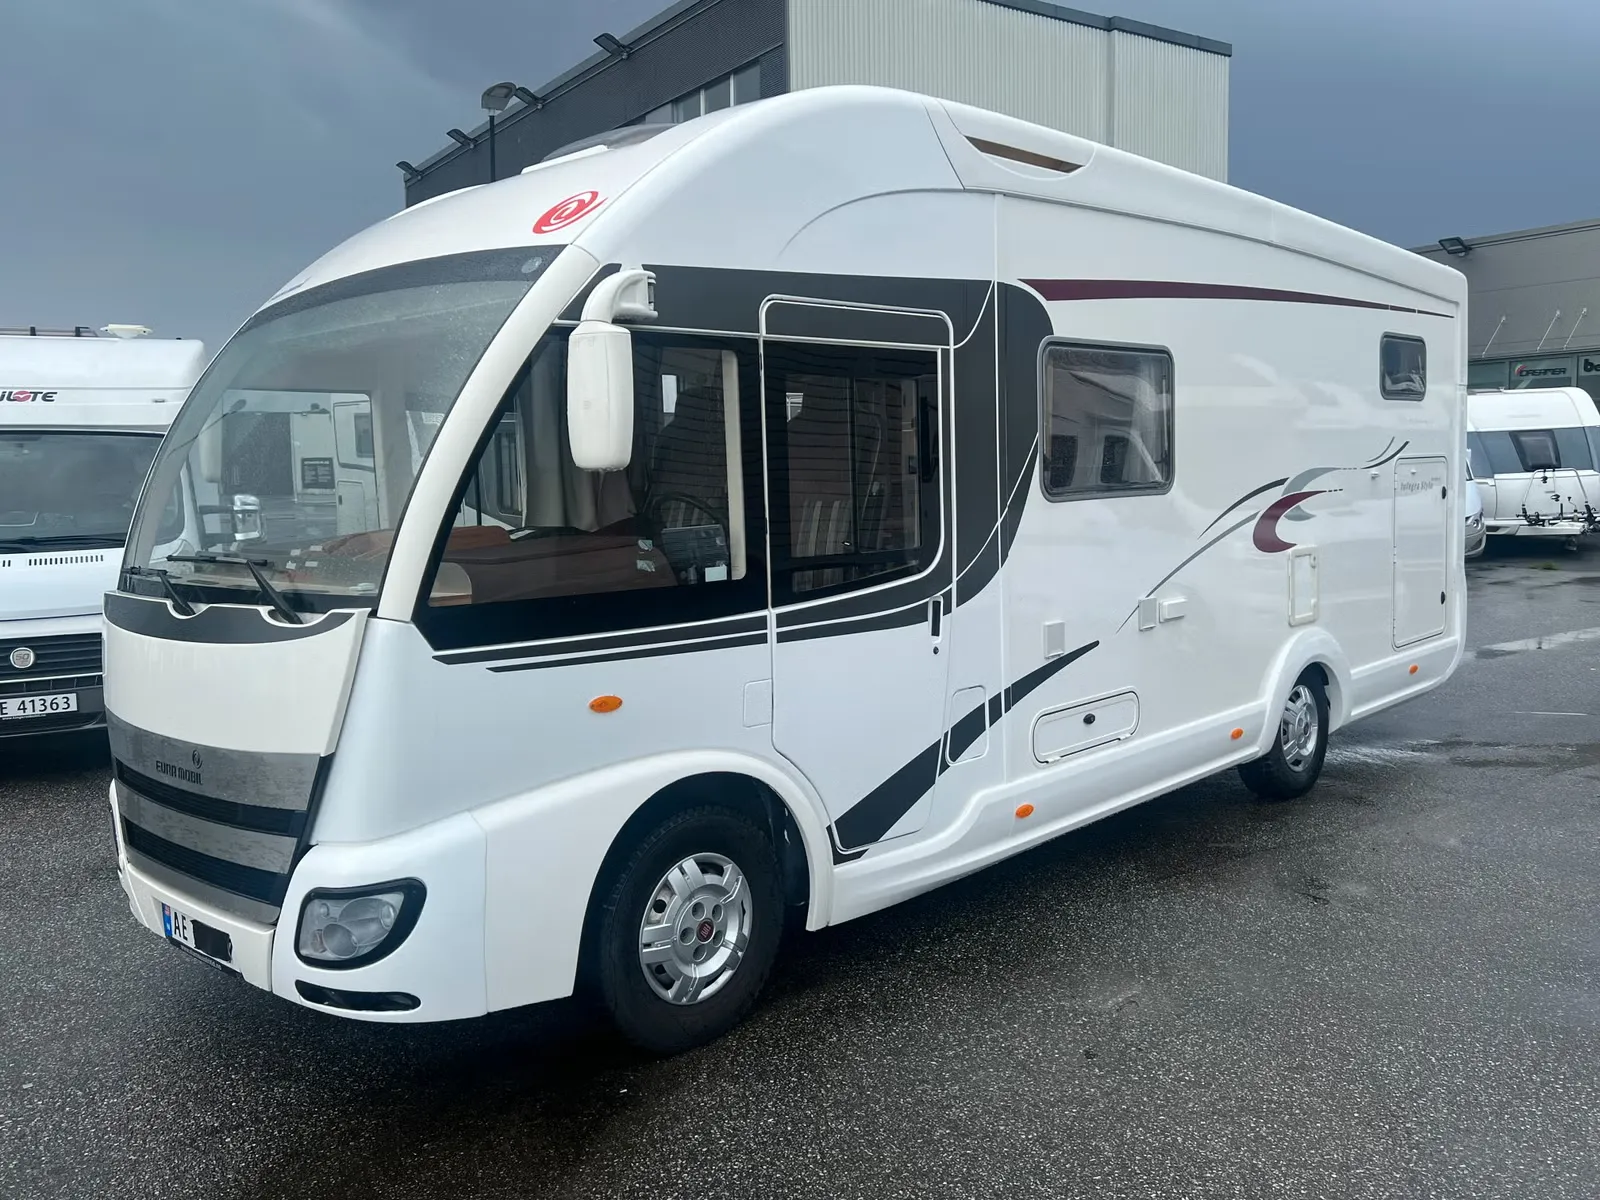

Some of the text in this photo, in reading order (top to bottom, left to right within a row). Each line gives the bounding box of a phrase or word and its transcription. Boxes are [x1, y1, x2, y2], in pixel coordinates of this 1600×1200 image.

[17, 696, 71, 714] 41363
[178, 766, 204, 786] MOBIL
[173, 911, 188, 941] AE
